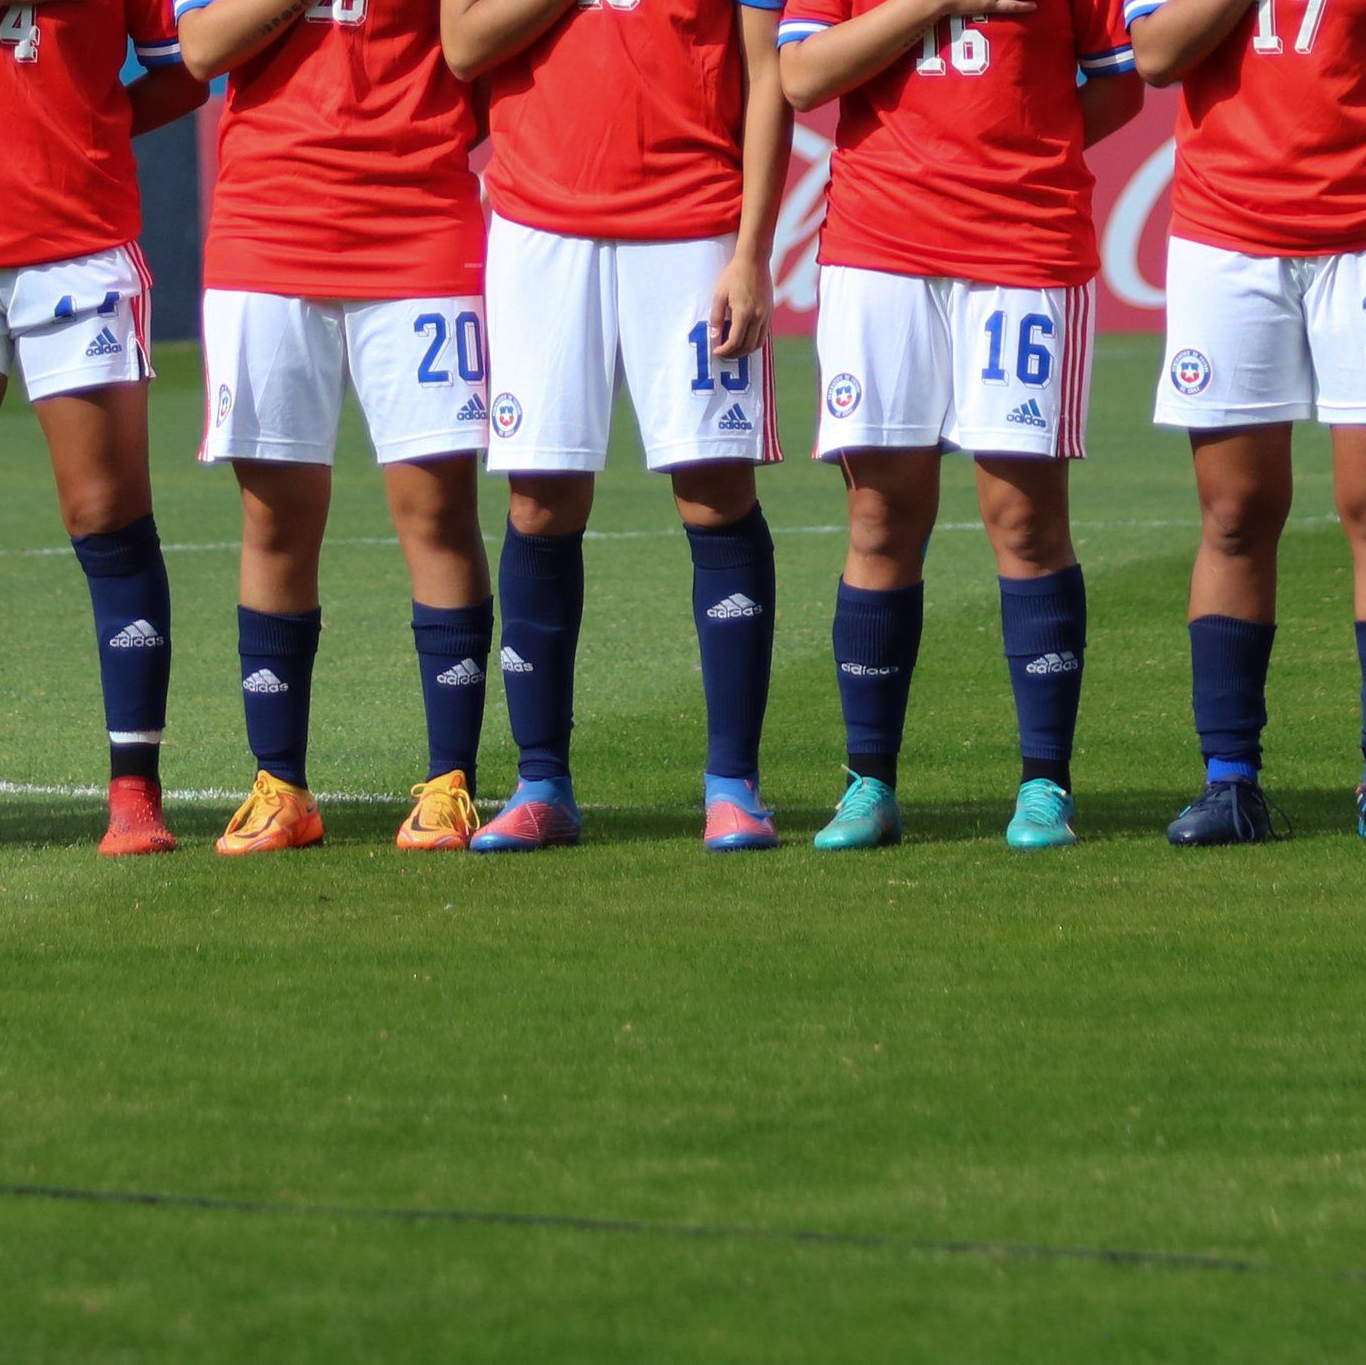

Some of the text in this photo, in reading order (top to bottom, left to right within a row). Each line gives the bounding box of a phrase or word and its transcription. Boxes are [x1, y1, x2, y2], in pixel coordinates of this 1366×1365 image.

[916, 14, 990, 76] 16
[85, 342, 123, 357] adidas
[413, 311, 485, 388] 20
[981, 310, 1055, 390] 16
[456, 409, 488, 422] adida
[1006, 412, 1047, 429] adidas
[718, 418, 753, 431] adidas
[707, 604, 763, 619] adidas
[109, 634, 165, 648] adidas
[1025, 658, 1079, 675] adidas
[436, 671, 485, 686] adidas
[242, 680, 289, 694] adidas
